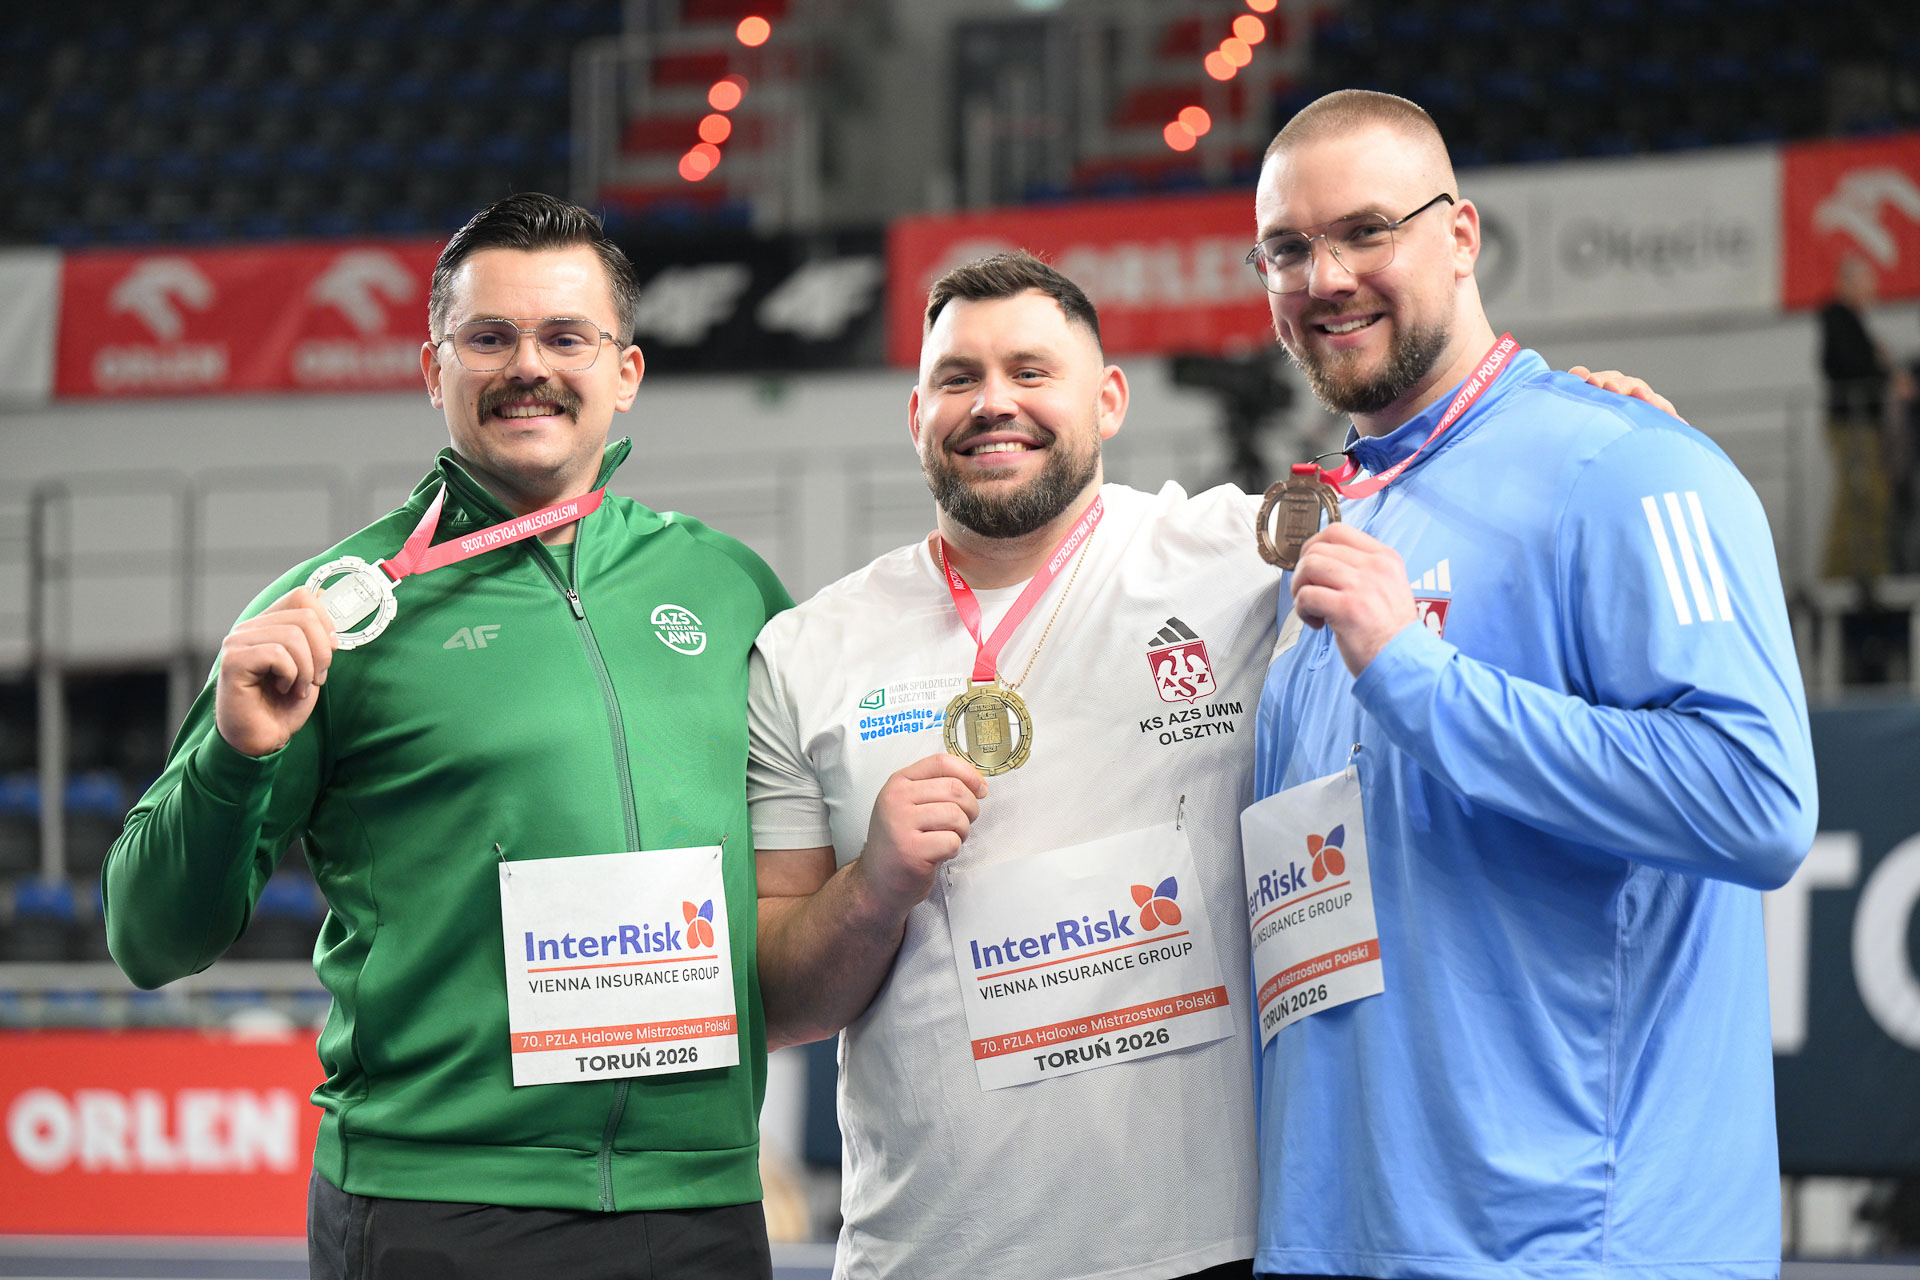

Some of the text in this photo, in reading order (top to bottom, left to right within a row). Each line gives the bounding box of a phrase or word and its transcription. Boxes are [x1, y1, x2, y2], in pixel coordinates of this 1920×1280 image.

[1477, 350, 1506, 382] POLSKI
[461, 503, 578, 552] MISTRZOSTWA POLSKI 2026
[1048, 520, 1090, 576] MISTRZOSTWA
[660, 612, 690, 625] AZS
[442, 624, 501, 650] 4F
[668, 631, 701, 645] AWF
[898, 690, 937, 703] SZCZYTNIE
[859, 708, 933, 729] olsztyńskie
[860, 720, 924, 741] wodociągi
[1140, 701, 1243, 733] KS AZS UWM
[1159, 720, 1235, 746] OLSZTYN
[1308, 892, 1353, 919] GROUP
[524, 921, 682, 962] InterRisk
[969, 909, 1135, 970] InterRisk
[528, 966, 720, 994] VIENNA INSURANCE GROUP
[979, 942, 1193, 1001] VIENNA INSURANCE GROUP
[1277, 958, 1332, 989] Mistrzostwa
[1334, 944, 1369, 967] Polski
[980, 991, 1216, 1055] 70. PZLA Halowe Mistrzostwa Polski
[1263, 984, 1327, 1033] TORUŃ 2026
[521, 1018, 731, 1049] 70. PZLA Halowe Mistrzostwa Polski
[1033, 1027, 1170, 1072] TORUŃ 2026
[575, 1046, 699, 1073] TORUŃ 2026
[7, 1086, 296, 1174] ORLEN
